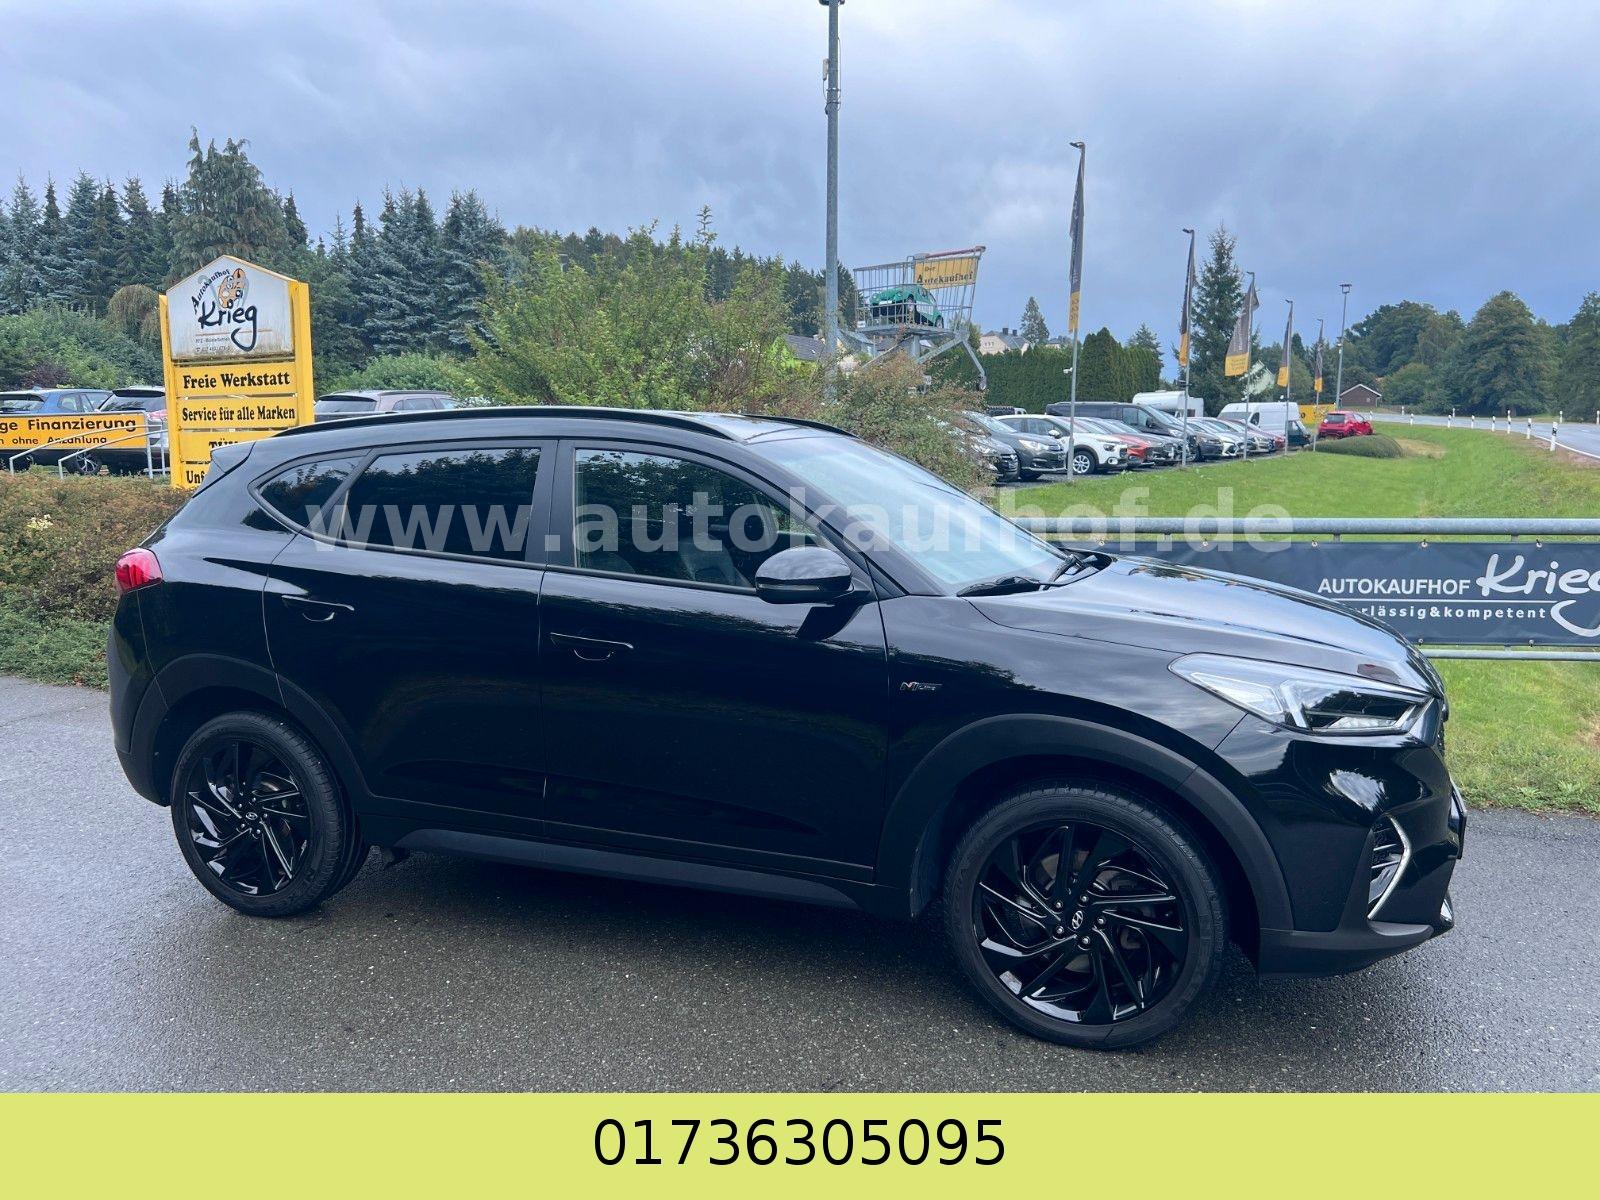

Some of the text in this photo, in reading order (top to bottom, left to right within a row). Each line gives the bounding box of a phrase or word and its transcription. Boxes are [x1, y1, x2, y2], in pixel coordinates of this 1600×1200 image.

[198, 301, 258, 352] Krieg
[183, 372, 291, 389] Freie Werkstatt
[182, 405, 296, 421] Service für alle Marken
[28, 418, 137, 433] Finanzierung
[12, 437, 39, 445] ohne
[1317, 578, 1471, 596] AUTOKAUFHOF
[1355, 604, 1546, 621] rlässig&kompetent
